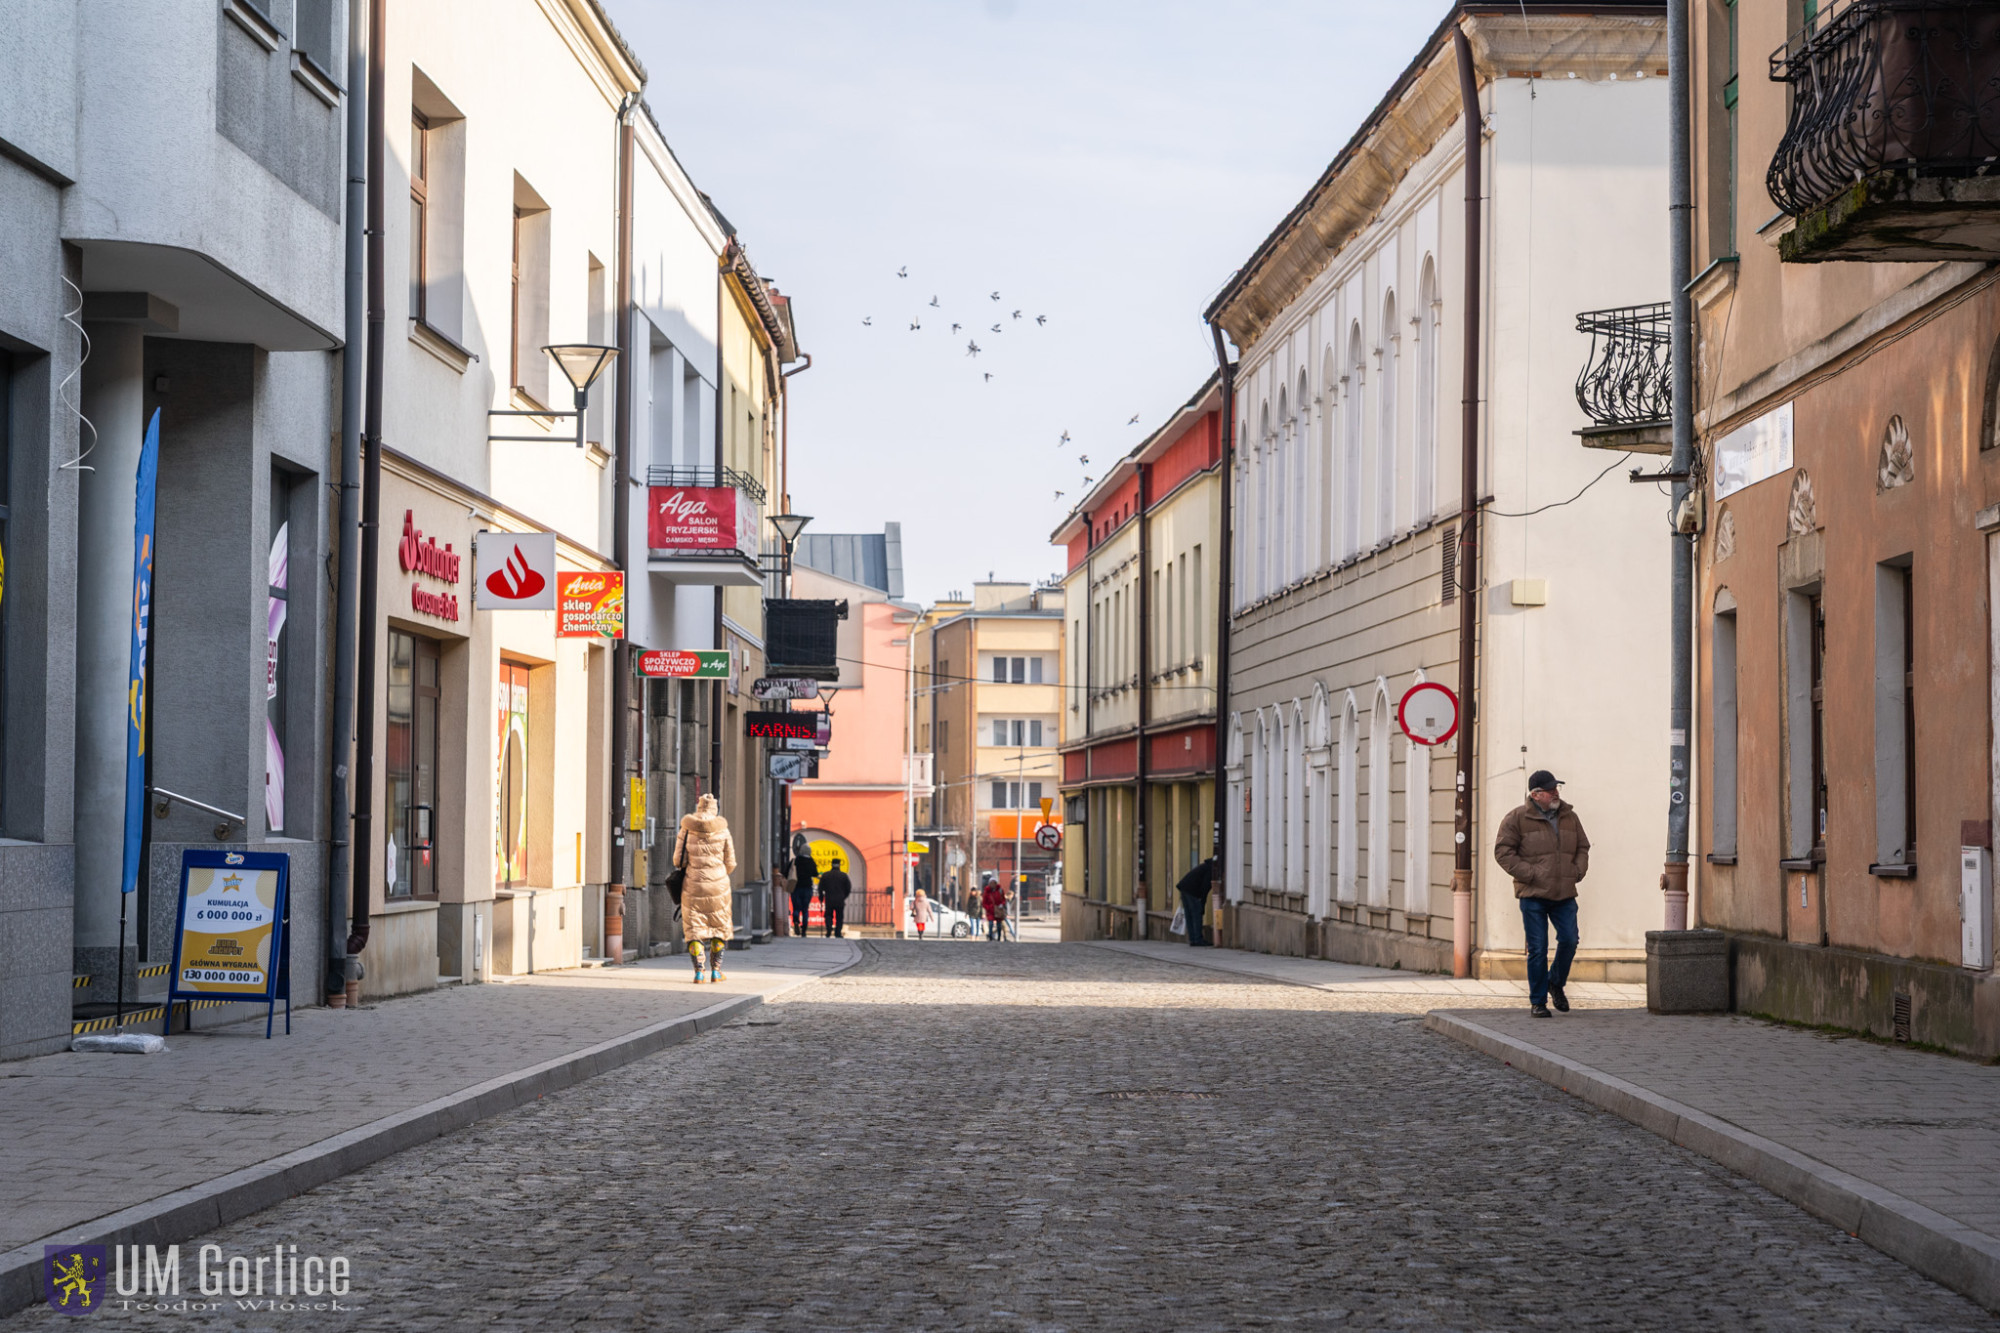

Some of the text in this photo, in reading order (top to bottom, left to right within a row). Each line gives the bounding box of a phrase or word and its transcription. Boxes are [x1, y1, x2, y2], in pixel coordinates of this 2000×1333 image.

[660, 491, 707, 522] Aga
[688, 517, 718, 525] SALON
[666, 526, 718, 534] FRYZJERSKI
[414, 529, 461, 584] Santander
[563, 575, 604, 596] Ania
[563, 599, 592, 612] sklep
[563, 611, 622, 623] gospodarczo
[563, 621, 612, 632] chemiczny
[709, 659, 727, 672] Agi
[207, 899, 249, 908] KUMULACJA
[197, 910, 262, 922] 6 000 000 zł
[190, 959, 258, 969] GŁÓWNA WYGRANA
[184, 969, 201, 980] 130
[204, 970, 225, 981] 000
[228, 971, 250, 982] 000
